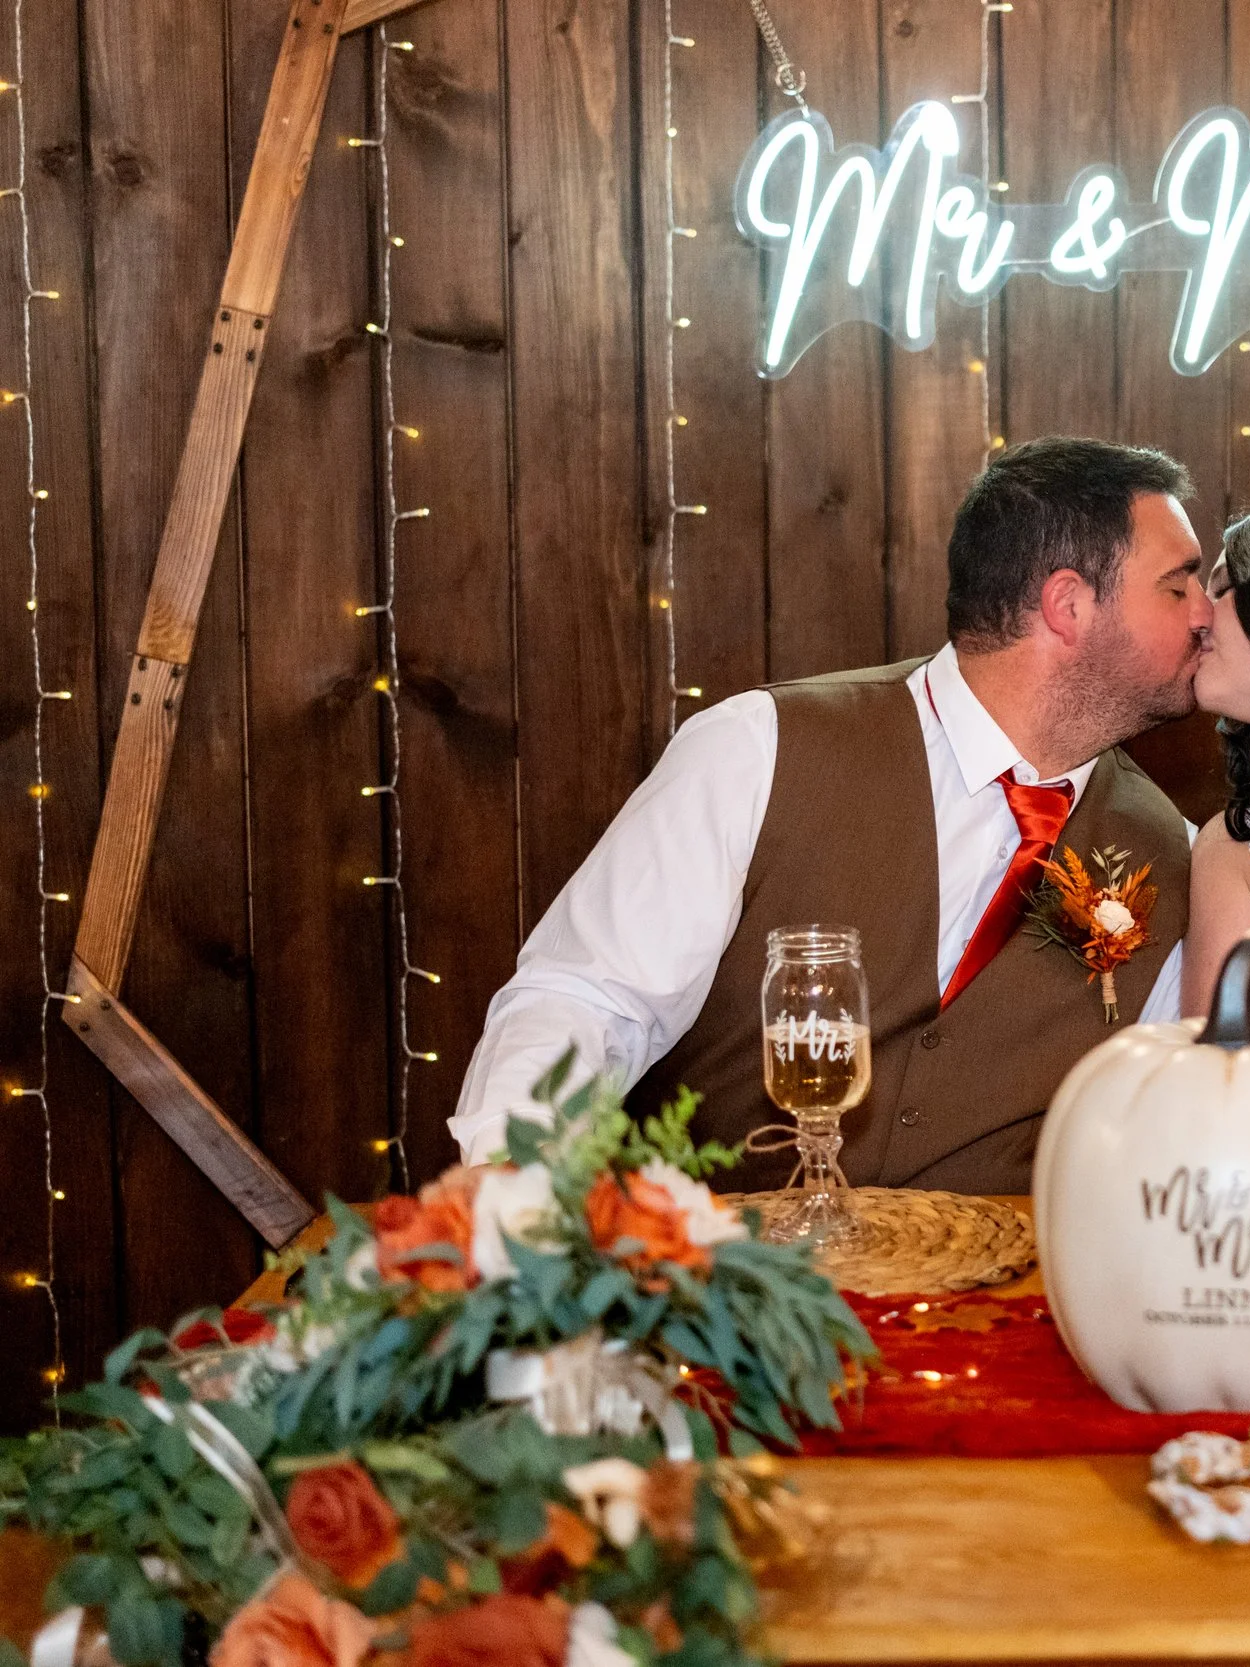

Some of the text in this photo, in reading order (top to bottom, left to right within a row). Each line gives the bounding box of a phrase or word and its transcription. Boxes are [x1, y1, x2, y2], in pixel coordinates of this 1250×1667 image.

[746, 98, 1012, 368] Mr
[1050, 175, 1124, 278] &
[788, 1010, 843, 1063] Mr.
